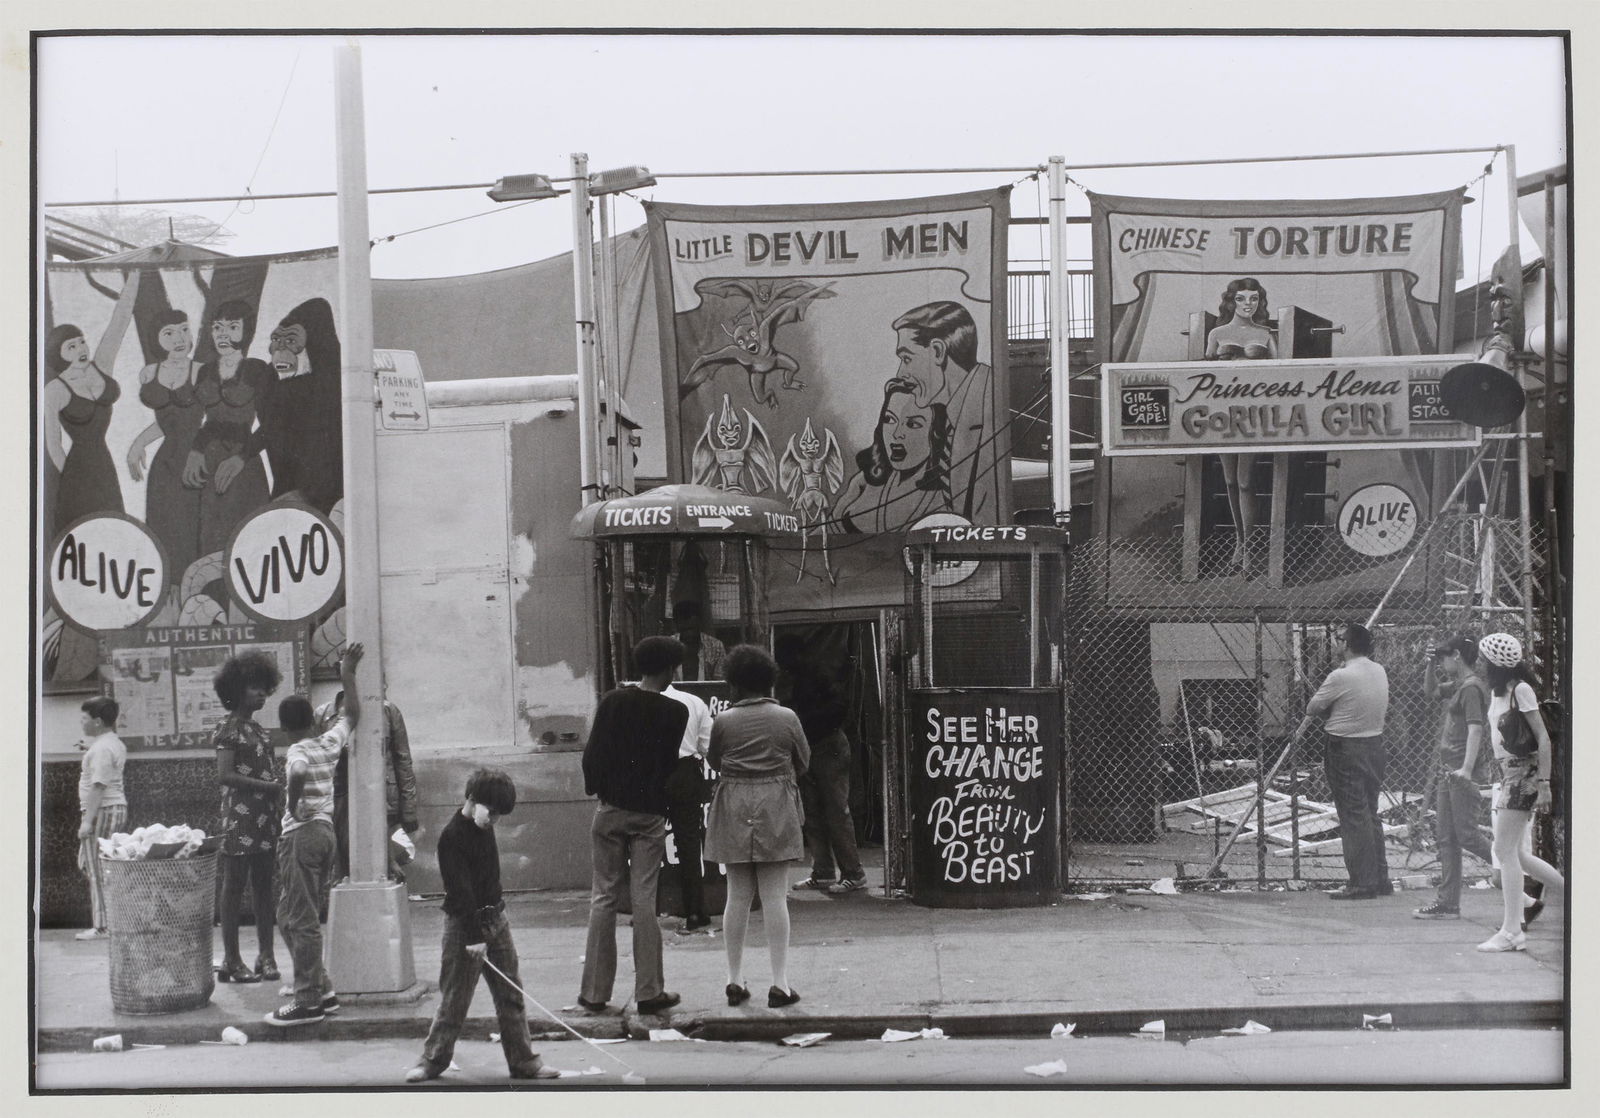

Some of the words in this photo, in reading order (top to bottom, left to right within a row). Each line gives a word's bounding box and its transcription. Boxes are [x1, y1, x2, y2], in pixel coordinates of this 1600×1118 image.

[675, 234, 733, 260] LITTLE
[746, 229, 859, 265] DEVIL
[883, 220, 969, 259] MEN
[1118, 227, 1210, 251] CHINESE
[1233, 222, 1413, 258] TORTURE
[382, 376, 419, 388] PARKING
[1176, 372, 1304, 404] Princess
[1308, 369, 1402, 400] Alena
[1123, 391, 1154, 404] GIRL
[1128, 402, 1160, 416] GOES
[1135, 406, 1167, 424] APE!
[1181, 403, 1309, 439] GORILLA
[1321, 401, 1403, 437] GIRL
[1412, 404, 1450, 419] STAG
[605, 506, 672, 527] TICKETS
[686, 504, 752, 517] ENTRANCE
[764, 511, 798, 533] TICKETS
[1346, 502, 1411, 537] ALIVE
[931, 527, 1027, 543] TICKETS
[58, 533, 156, 607] ALIVE
[235, 523, 330, 604] VIVO
[146, 626, 256, 642] AUTHENTIC
[926, 707, 978, 743] SEE
[985, 707, 1039, 744] HER
[925, 744, 1044, 783] CHANGE
[973, 833, 1005, 857] to
[941, 840, 1035, 884] BEAST
